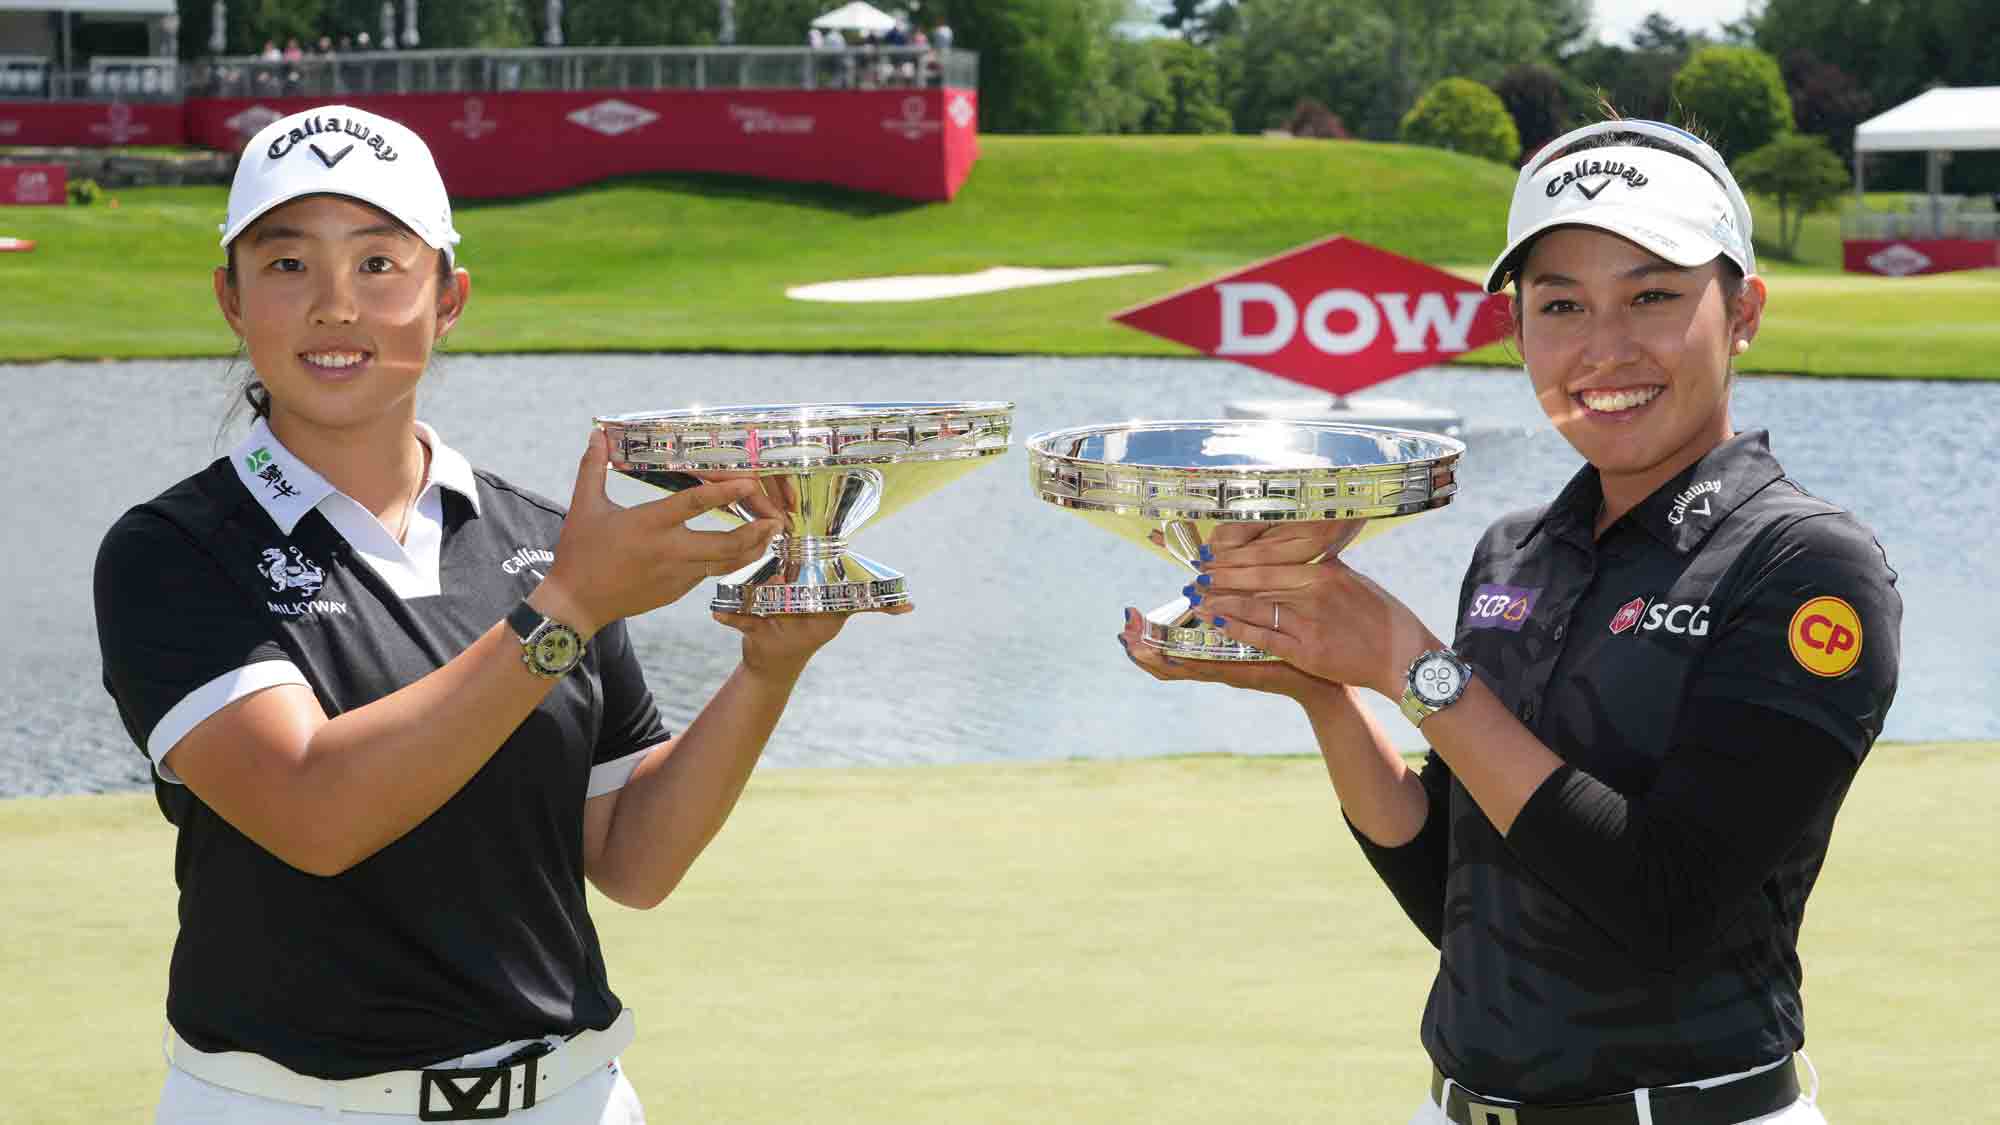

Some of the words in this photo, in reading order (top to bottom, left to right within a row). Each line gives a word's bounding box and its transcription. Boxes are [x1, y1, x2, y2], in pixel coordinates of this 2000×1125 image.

[267, 115, 398, 162] Callaway
[1545, 159, 1649, 198] Callaway
[1213, 281, 1485, 357] DOW
[1668, 479, 1721, 525] Callaway
[502, 547, 555, 574] Callaw
[1470, 594, 1511, 618] SCB
[1642, 603, 1711, 636] SCG
[1800, 614, 1855, 655] CP
